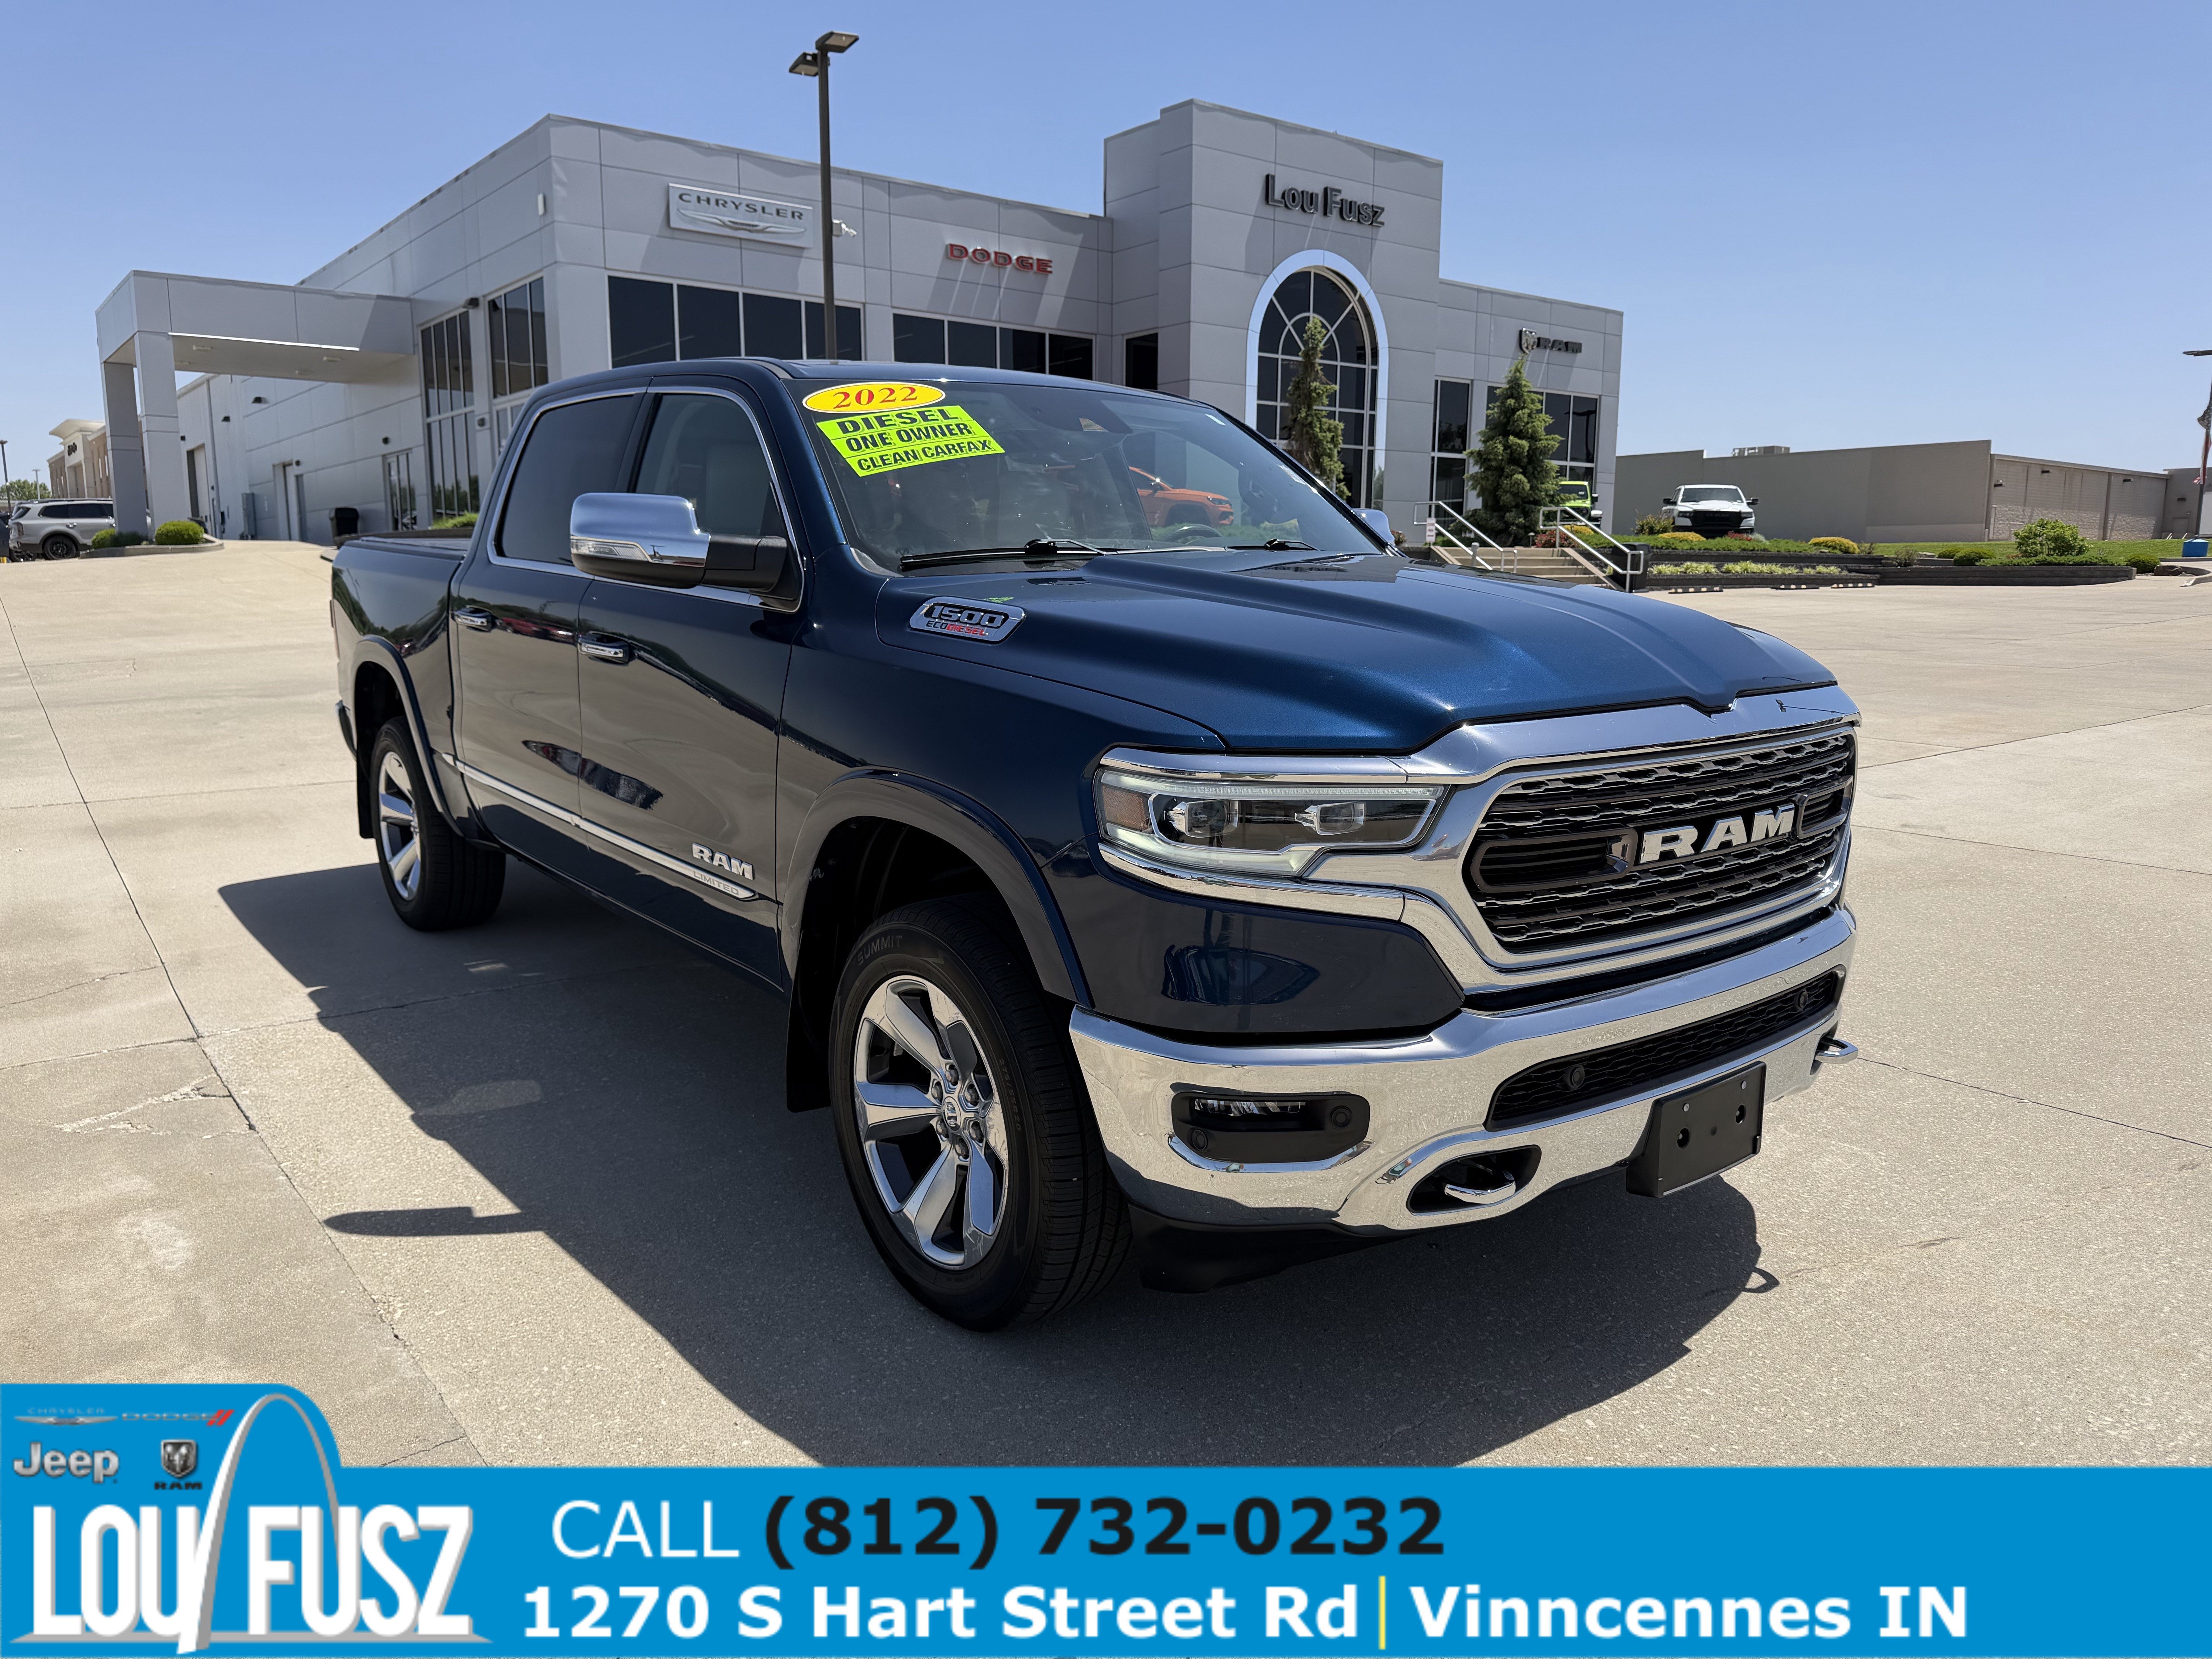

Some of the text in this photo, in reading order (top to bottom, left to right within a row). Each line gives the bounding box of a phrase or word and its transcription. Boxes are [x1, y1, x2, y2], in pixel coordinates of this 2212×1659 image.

[678, 193, 804, 220] CHRYSLER
[1265, 173, 1385, 227] Lou Fusz
[946, 243, 1053, 274] DODGE
[1537, 337, 1582, 354] RAM
[833, 386, 918, 409] 2022
[836, 409, 960, 434] DIESEL
[845, 422, 973, 452] ONE OWNER
[857, 439, 994, 471] CLEAN CARFAX
[926, 620, 988, 636] ECODIESEL
[931, 605, 1005, 627] 1500
[1640, 802, 1795, 864] RAM
[692, 842, 755, 880] RAM
[693, 871, 739, 896] LIMITED
[857, 935, 903, 966] SUMMIT
